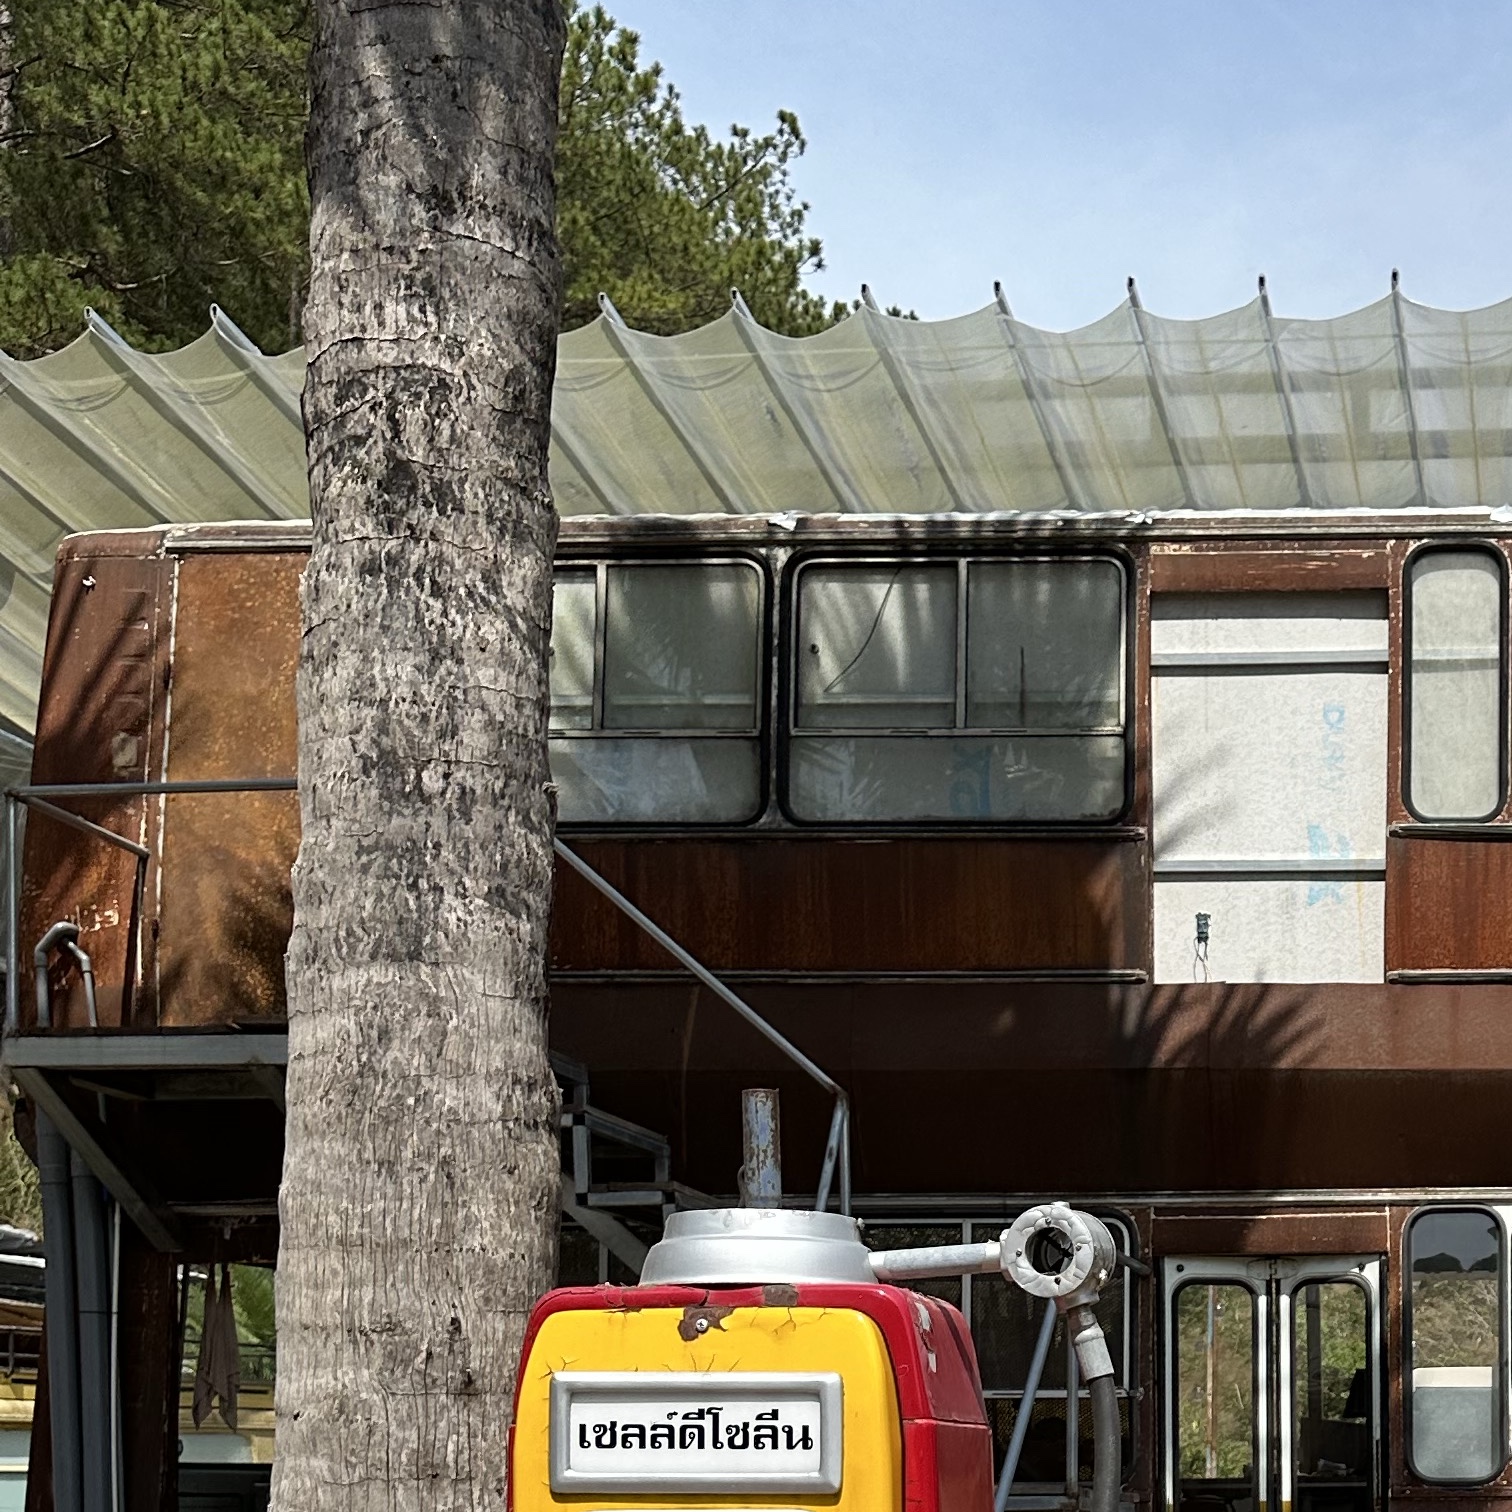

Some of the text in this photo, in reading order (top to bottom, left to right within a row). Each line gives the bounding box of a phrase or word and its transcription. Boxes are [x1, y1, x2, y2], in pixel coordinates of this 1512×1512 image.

[579, 1407, 813, 1450] เชลล์ดีโซลีน
